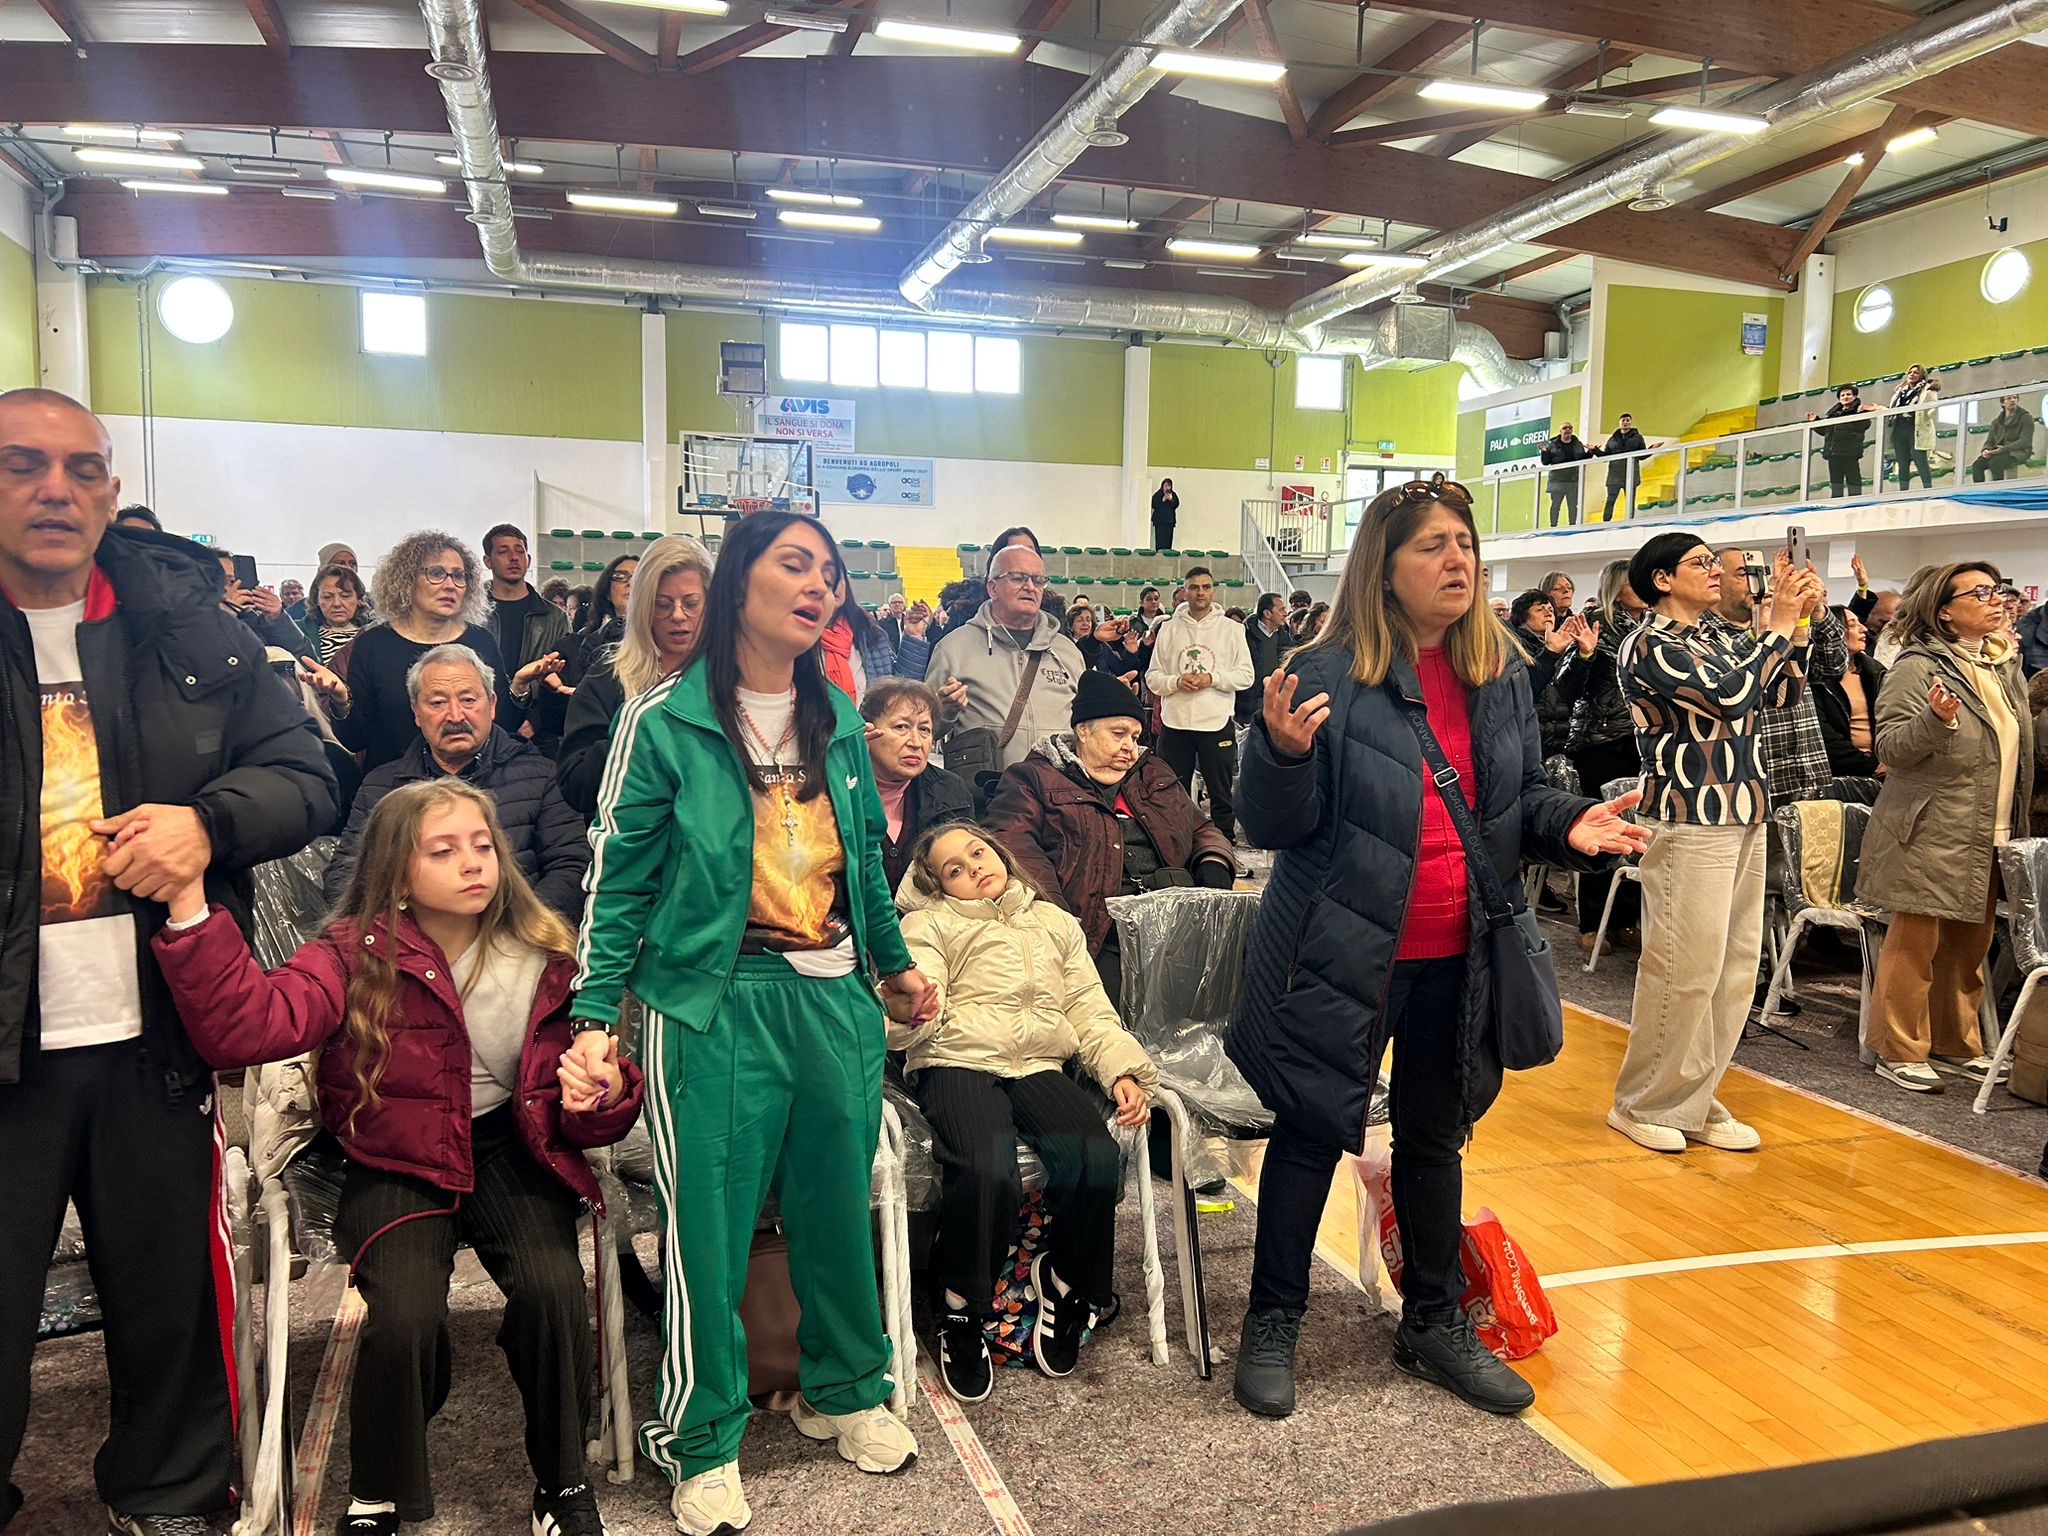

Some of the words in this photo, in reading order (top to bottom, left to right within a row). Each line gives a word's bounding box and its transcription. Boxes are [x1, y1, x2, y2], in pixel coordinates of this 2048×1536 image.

[780, 398, 830, 414] AVIS
[765, 417, 772, 425] IL
[774, 417, 807, 427] SANGUE
[810, 420, 818, 428] SI
[820, 420, 844, 429] DONA
[776, 428, 795, 436] NON
[806, 429, 834, 438] VERSA
[1490, 437, 1508, 452] PALA
[1522, 429, 1549, 445] GREEN
[823, 458, 857, 466] BENVENUTI
[869, 460, 900, 468] AGROPOLI
[758, 770, 795, 784] Sano
[1468, 836, 1488, 870] DUCK
